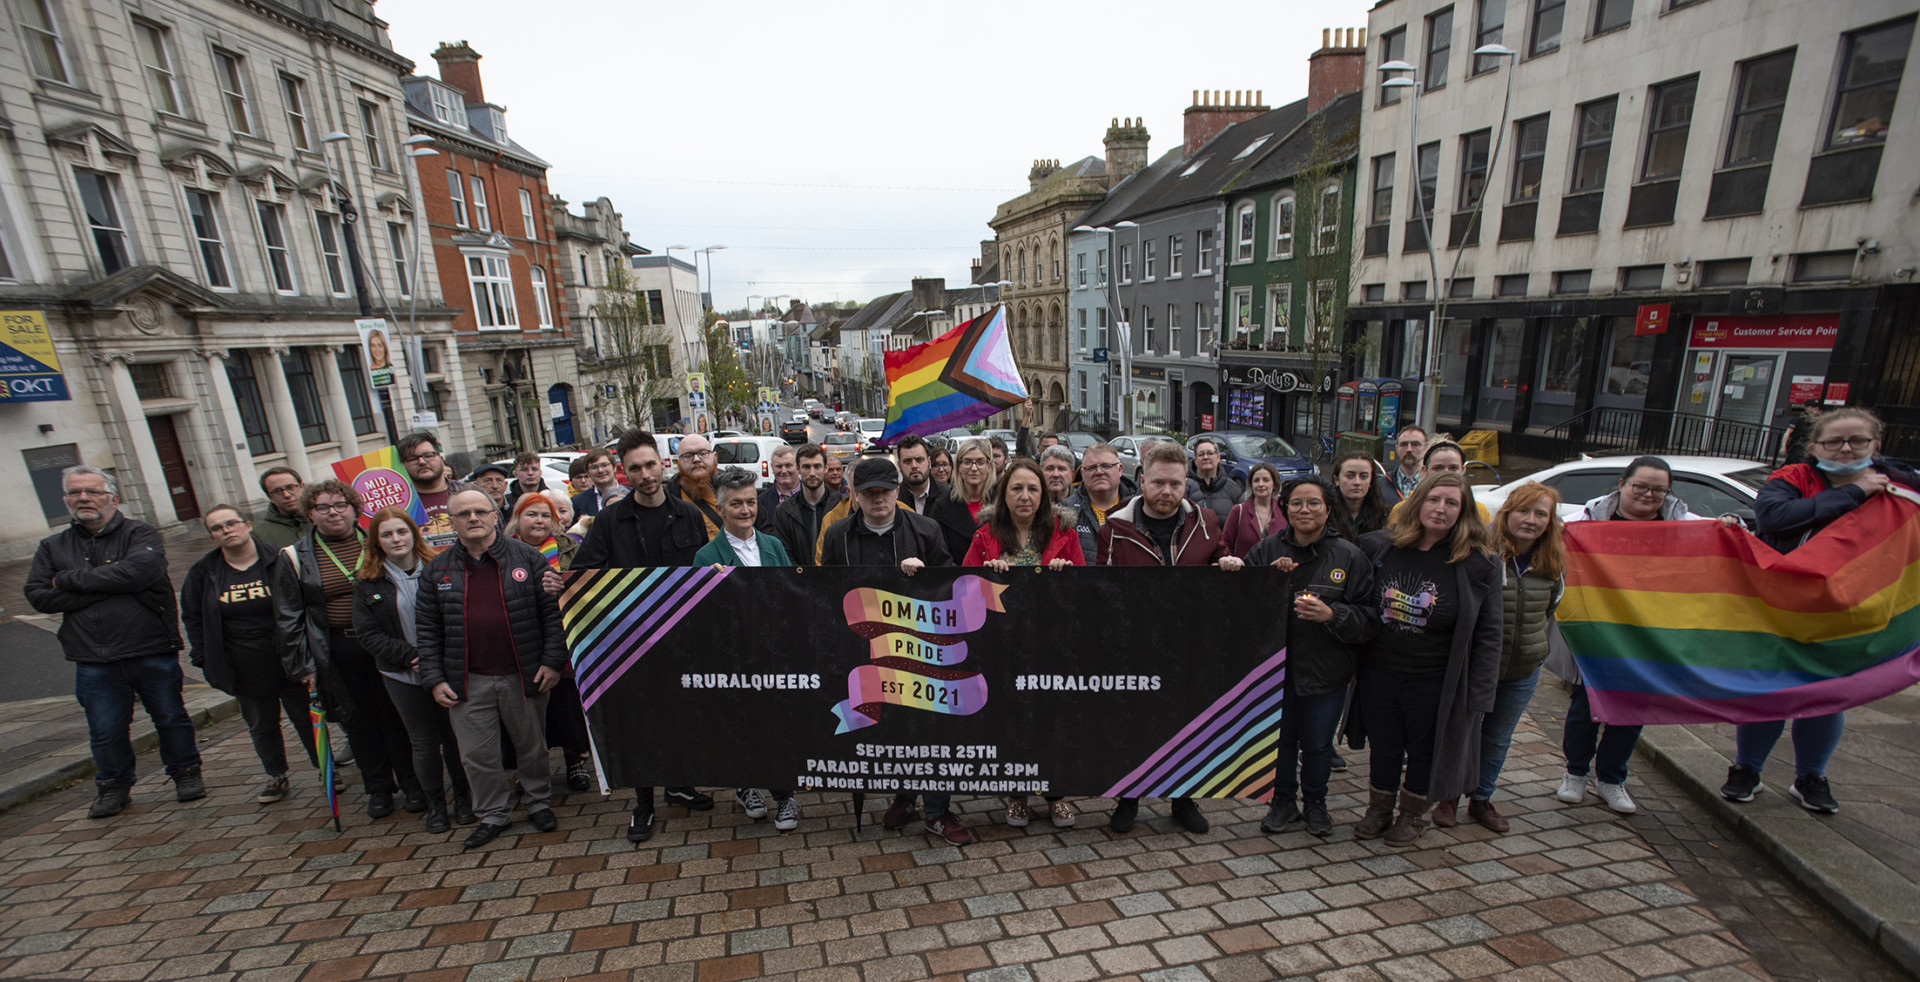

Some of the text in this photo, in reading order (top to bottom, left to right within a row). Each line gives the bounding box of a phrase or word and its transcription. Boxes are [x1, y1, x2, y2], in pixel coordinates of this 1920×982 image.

[4, 315, 34, 324] FOR
[7, 325, 44, 334] SALE
[1733, 326, 1838, 336] Customer Service Poin
[10, 378, 53, 393] OKT
[364, 476, 388, 491] MID
[367, 493, 404, 512] PRIDE
[1396, 593, 1421, 605] OMAGH
[882, 600, 957, 627] OMAGH
[895, 640, 943, 662] PRIDE
[680, 673, 821, 691] #RURALQUEERS
[1015, 674, 1161, 692] #RURALQUEERS
[881, 681, 958, 706] EST 2021
[856, 743, 997, 759] SEPTEMBER 25TH
[806, 759, 1039, 777] PARADE LEAVES SWC AT 3PM
[797, 775, 1050, 792] FOR MORE INFO SEARCH OMAGHPRIDE
